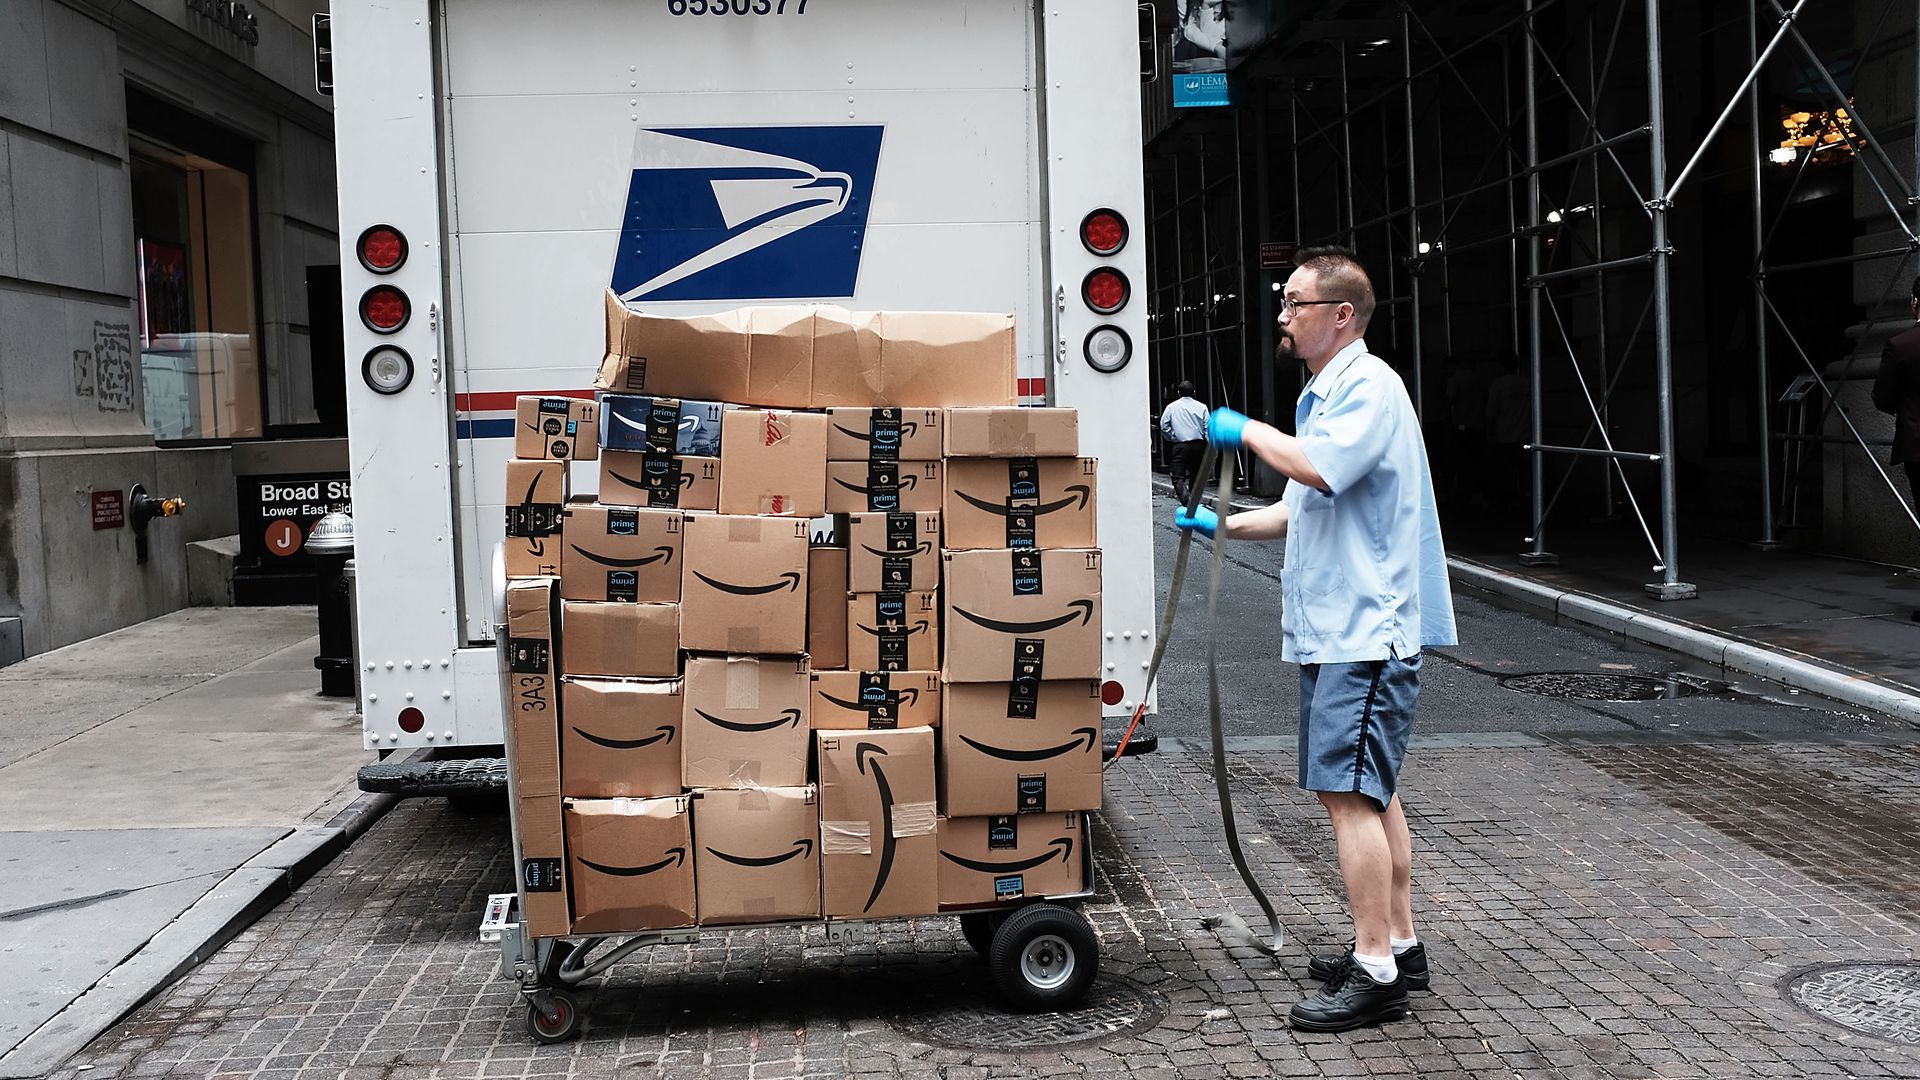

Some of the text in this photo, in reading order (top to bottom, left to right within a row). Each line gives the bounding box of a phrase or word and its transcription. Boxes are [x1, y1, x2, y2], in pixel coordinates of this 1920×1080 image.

[653, 408, 677, 418] prime
[875, 428, 899, 437] prime
[645, 460, 669, 468] prime
[261, 482, 352, 501] Broad St
[873, 494, 897, 503] prime
[262, 506, 298, 517] Lower
[302, 504, 328, 515] East
[611, 520, 635, 528] prime
[276, 527, 291, 548] J
[1010, 538, 1033, 546] prime
[611, 578, 635, 586] prime
[1015, 577, 1038, 586] prime
[879, 601, 903, 610] prime
[520, 676, 547, 711] 3A3
[862, 693, 886, 702] prime
[1020, 780, 1043, 789] prime
[531, 863, 541, 887] prime
